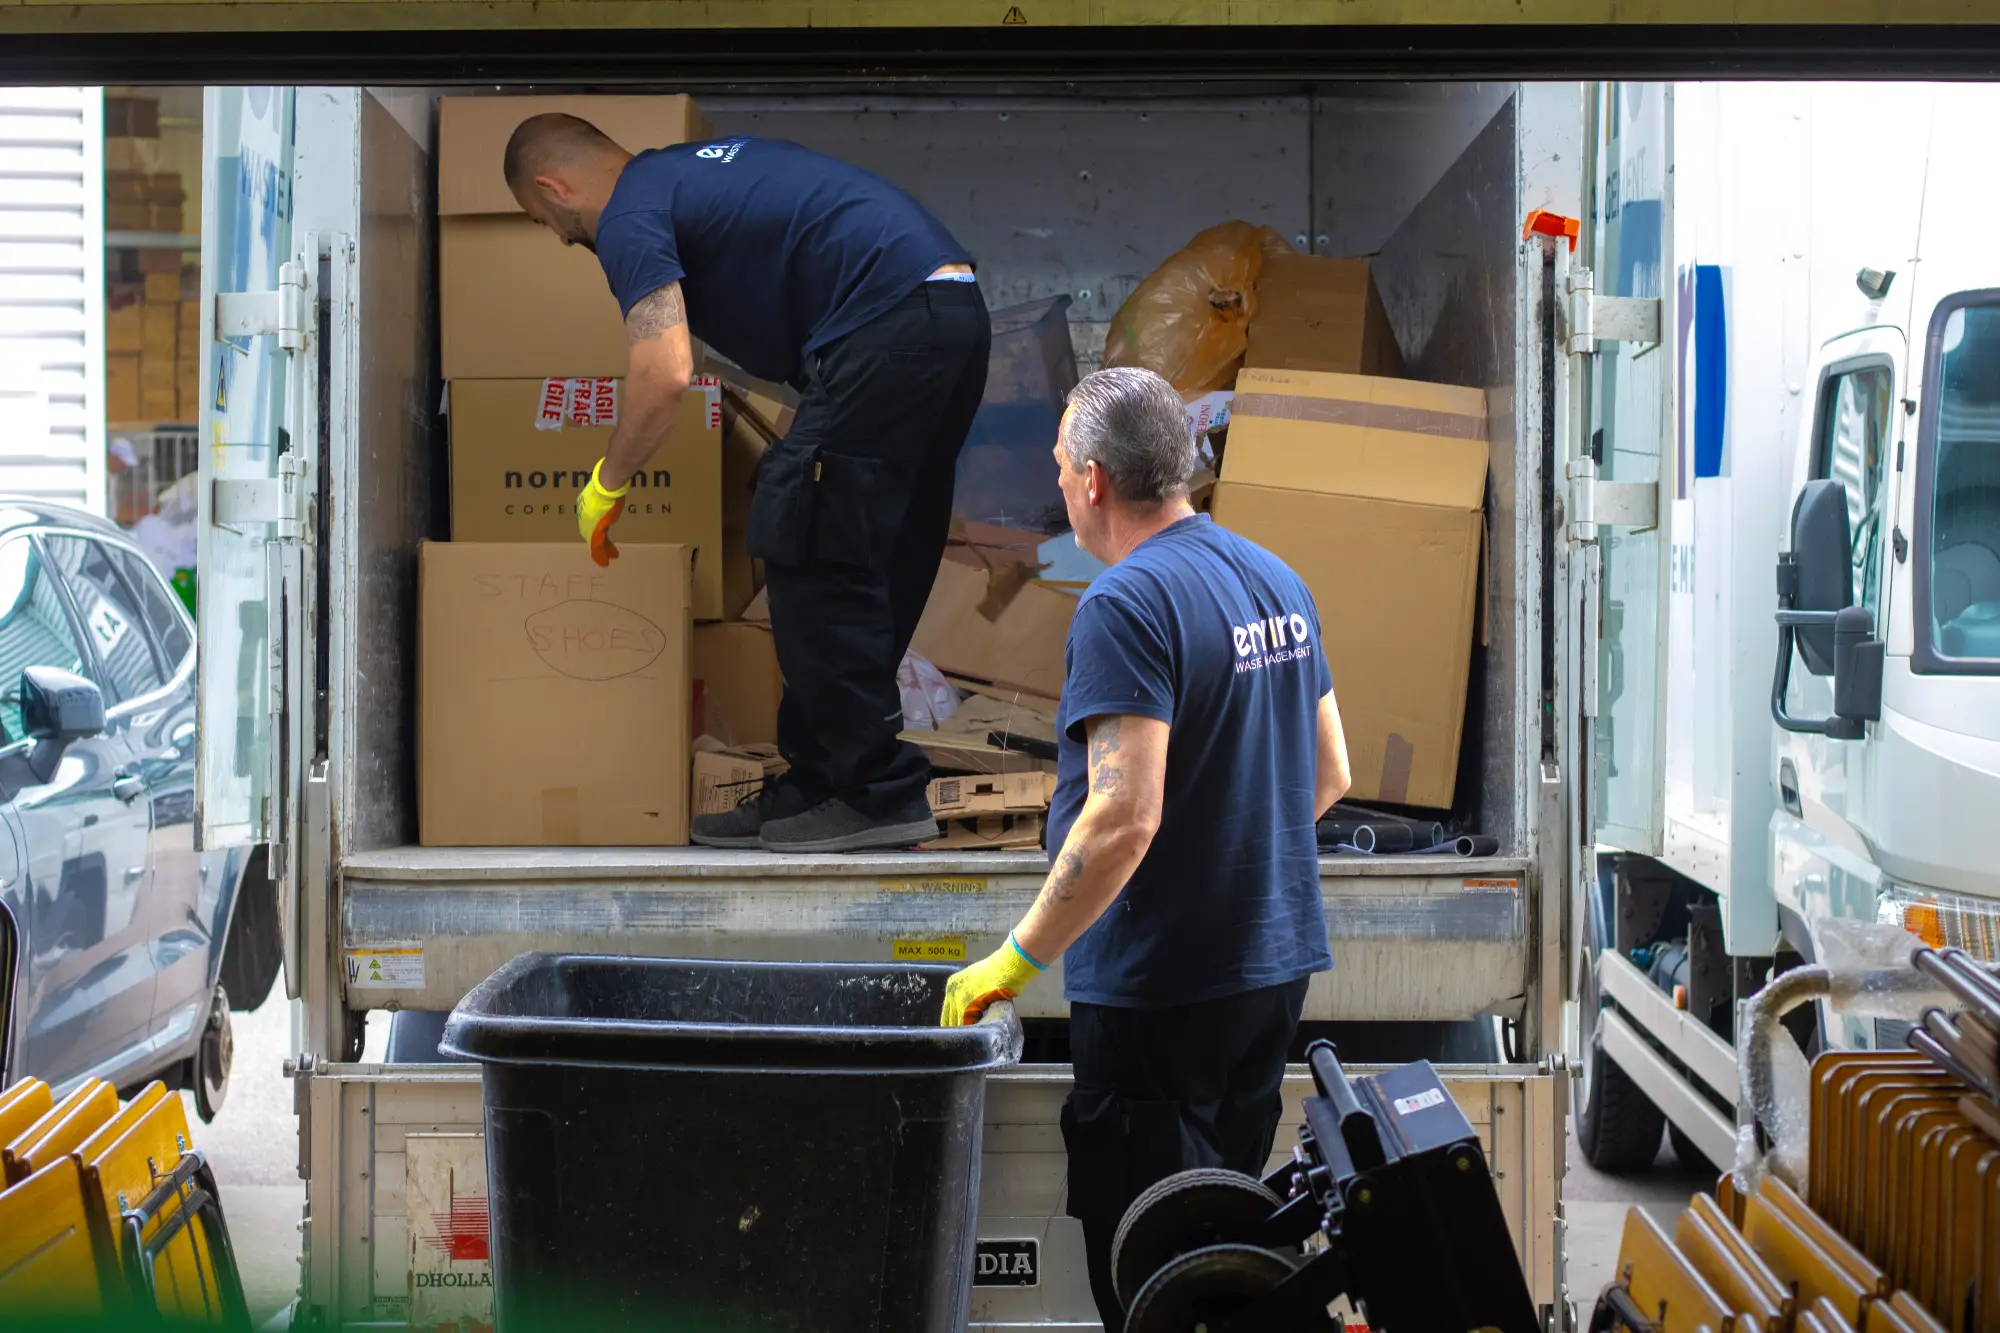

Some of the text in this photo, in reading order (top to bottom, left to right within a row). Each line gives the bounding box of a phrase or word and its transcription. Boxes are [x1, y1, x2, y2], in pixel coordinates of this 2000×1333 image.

[505, 470, 671, 489] normnn
[505, 503, 671, 515] COPEGEN
[474, 571, 606, 600] STAFF
[531, 625, 657, 653] SHOES
[928, 946, 945, 955] 500
[948, 946, 960, 956] kg
